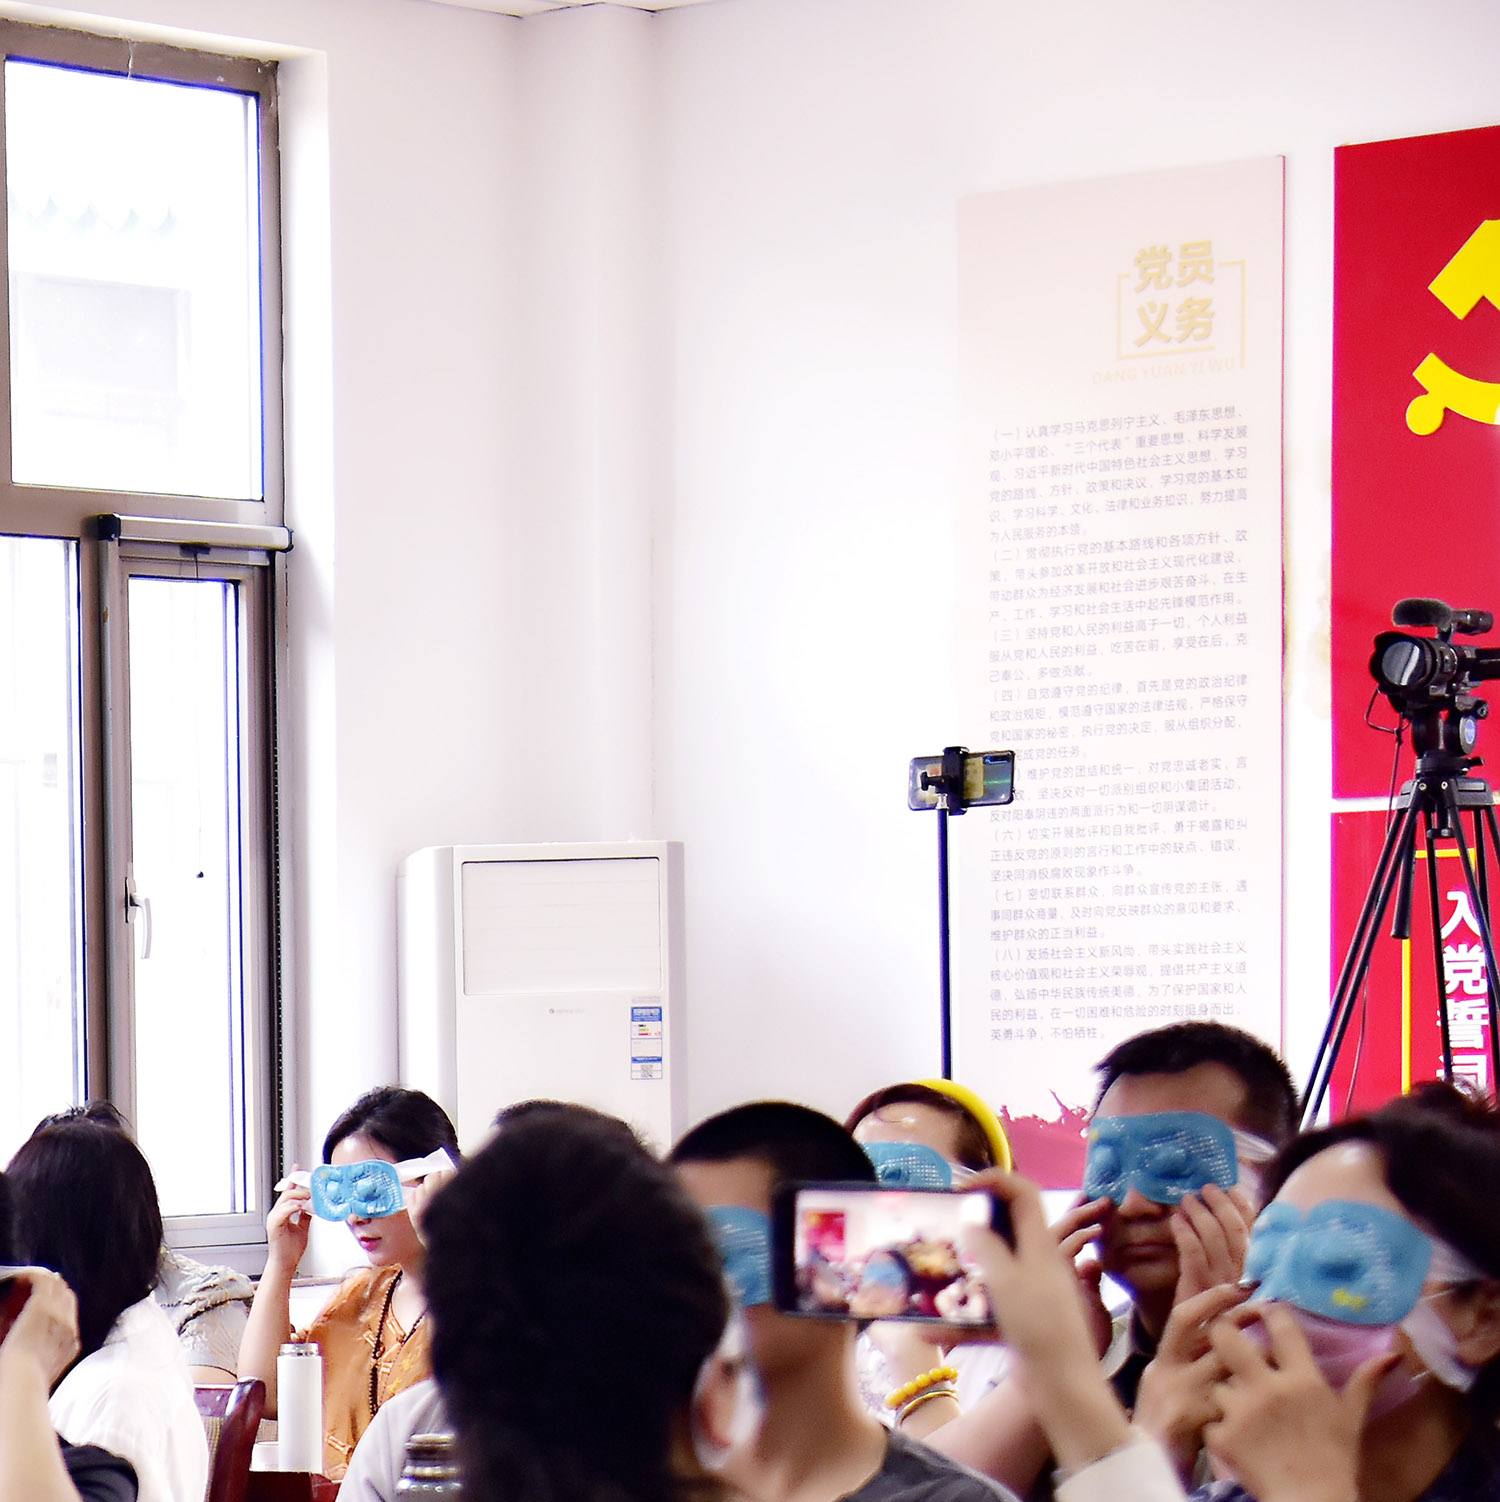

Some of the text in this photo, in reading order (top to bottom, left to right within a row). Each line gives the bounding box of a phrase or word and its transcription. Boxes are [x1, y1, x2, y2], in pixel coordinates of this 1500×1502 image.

[1134, 240, 1215, 293] 党员
[1134, 297, 1216, 348] 义务
[1092, 357, 1235, 385] DANG YUAN YI WU
